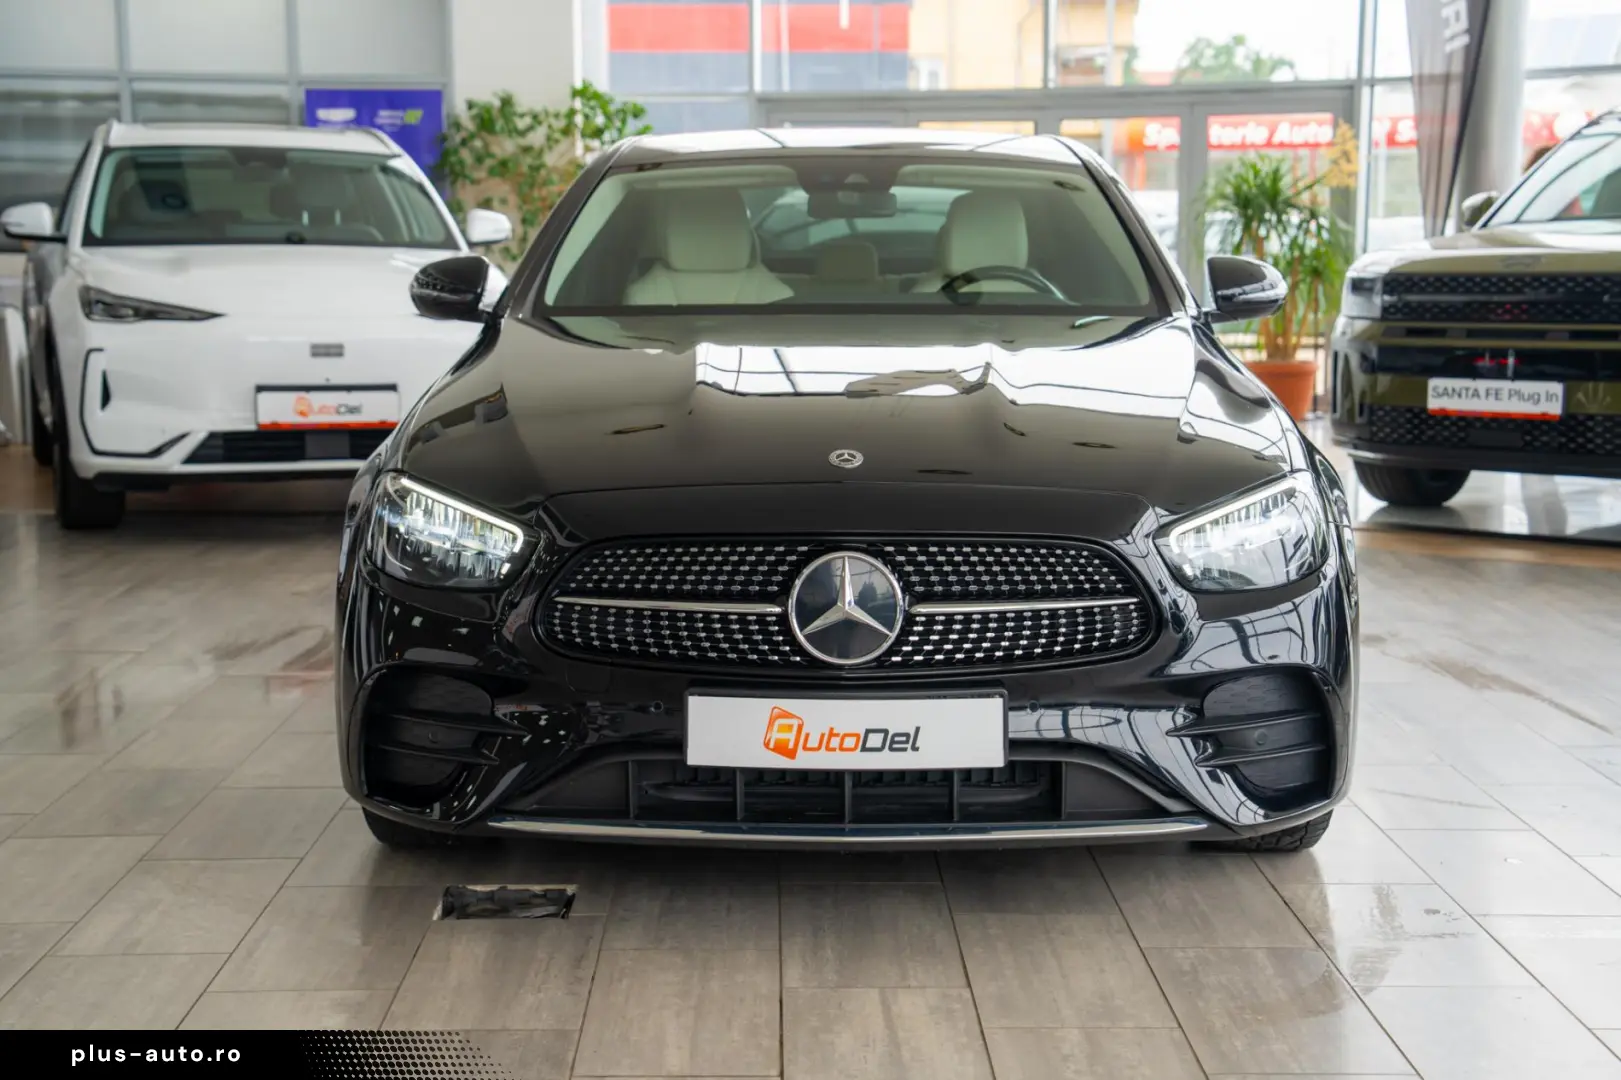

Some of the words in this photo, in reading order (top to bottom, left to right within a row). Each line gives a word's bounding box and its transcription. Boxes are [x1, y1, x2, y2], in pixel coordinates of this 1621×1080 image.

[1271, 120, 1333, 146] Auto
[1431, 385, 1482, 400] SANTA
[1485, 386, 1504, 401] FE
[1507, 388, 1541, 405] Plug
[1545, 390, 1560, 403] In
[763, 706, 921, 760] AutoDel
